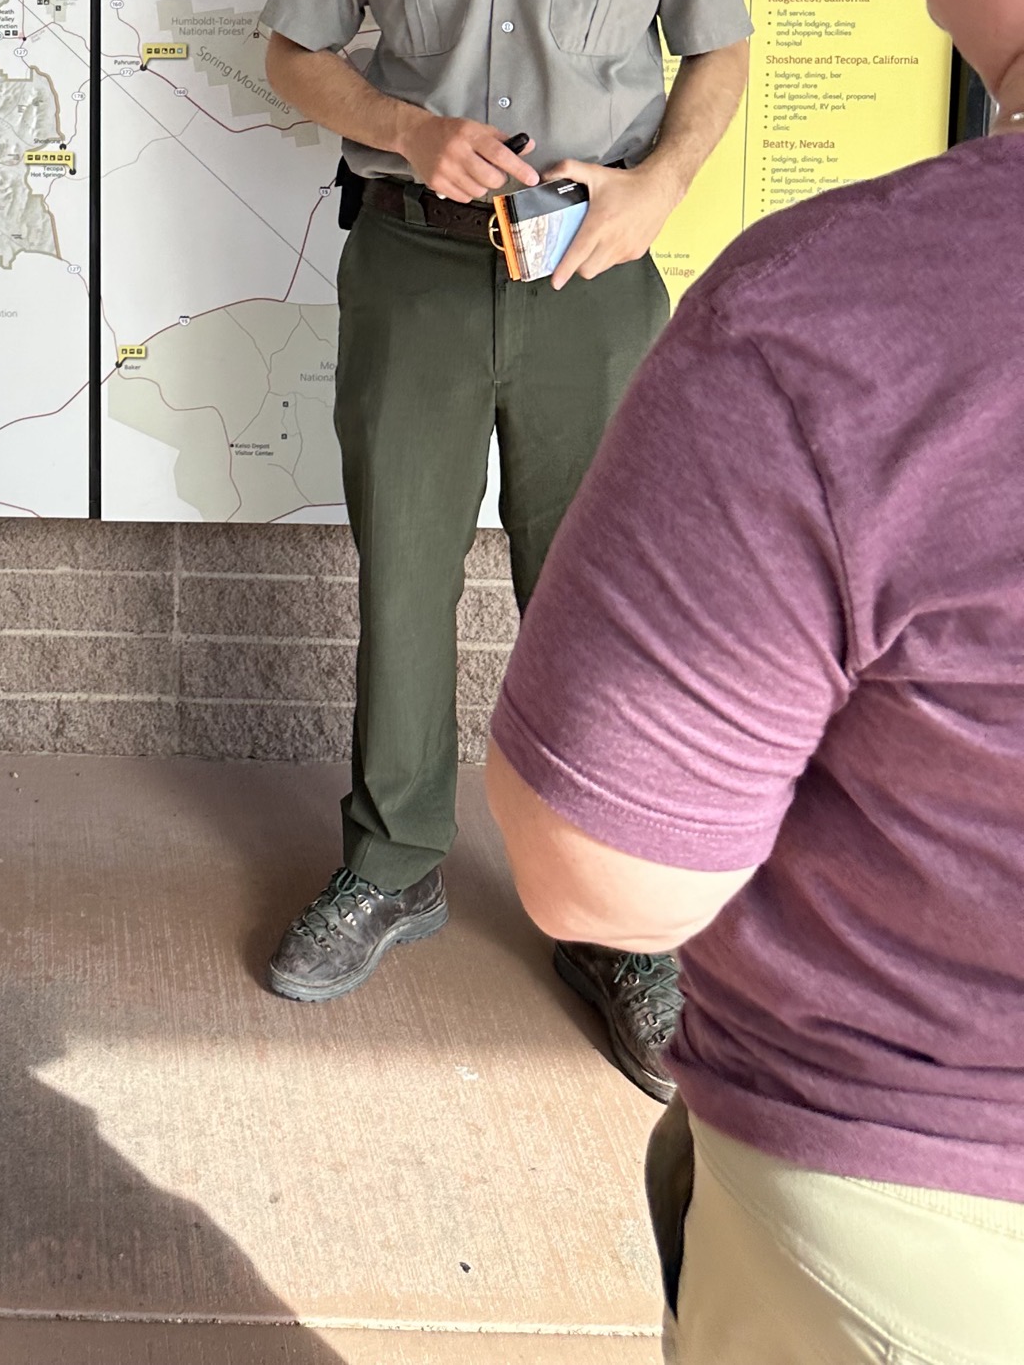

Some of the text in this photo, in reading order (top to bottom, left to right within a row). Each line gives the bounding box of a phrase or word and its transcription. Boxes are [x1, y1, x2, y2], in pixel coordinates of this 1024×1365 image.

[171, 16, 253, 26] Humboldt-Toiyabe
[179, 27, 245, 36] National Forest
[776, 39, 802, 47] hospital
[766, 55, 918, 66] Shoshone and Tecopa, California
[196, 45, 293, 115] Spring Mountains
[774, 82, 800, 90] general
[763, 140, 835, 150] Beatty, Nevada
[43, 171, 64, 179] Springs
[663, 267, 695, 278] Village
